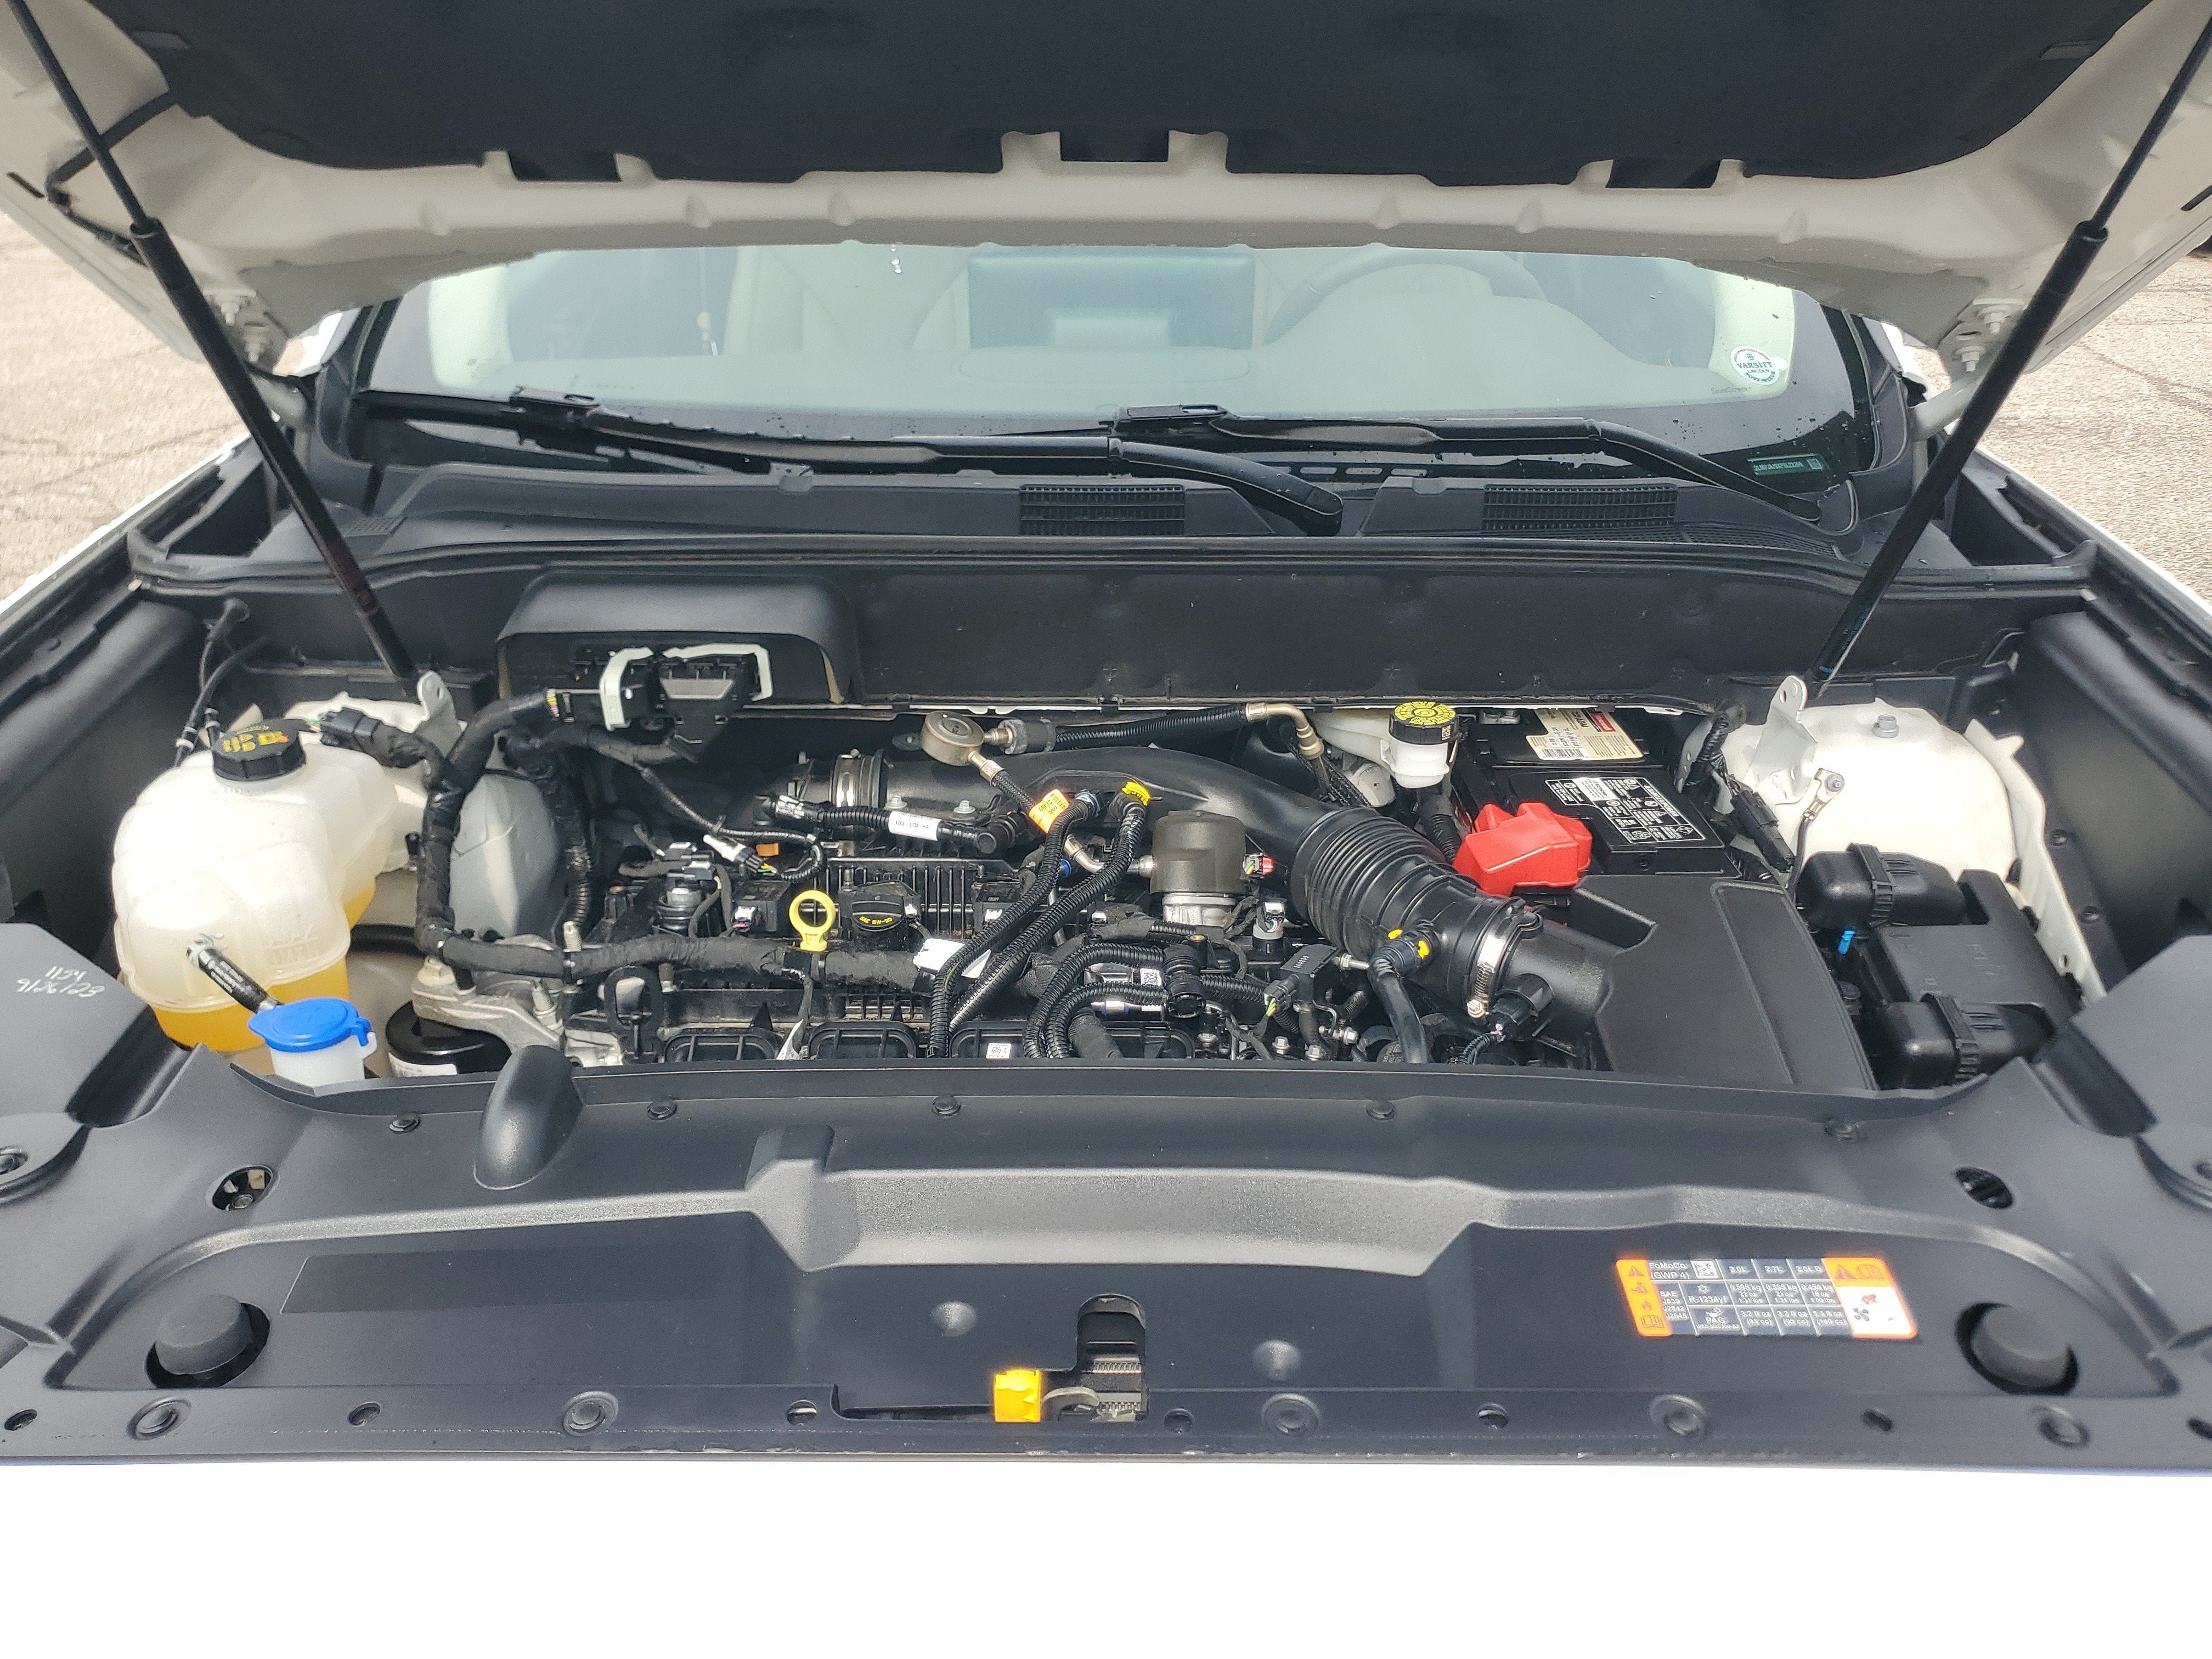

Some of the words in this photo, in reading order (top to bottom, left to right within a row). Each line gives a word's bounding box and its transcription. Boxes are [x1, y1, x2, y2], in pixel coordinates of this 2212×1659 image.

[1575, 718, 1589, 727] AGM
[1751, 1284, 1762, 1292] kg
[1787, 1284, 1799, 1292] kg
[1822, 1284, 1834, 1292] kg
